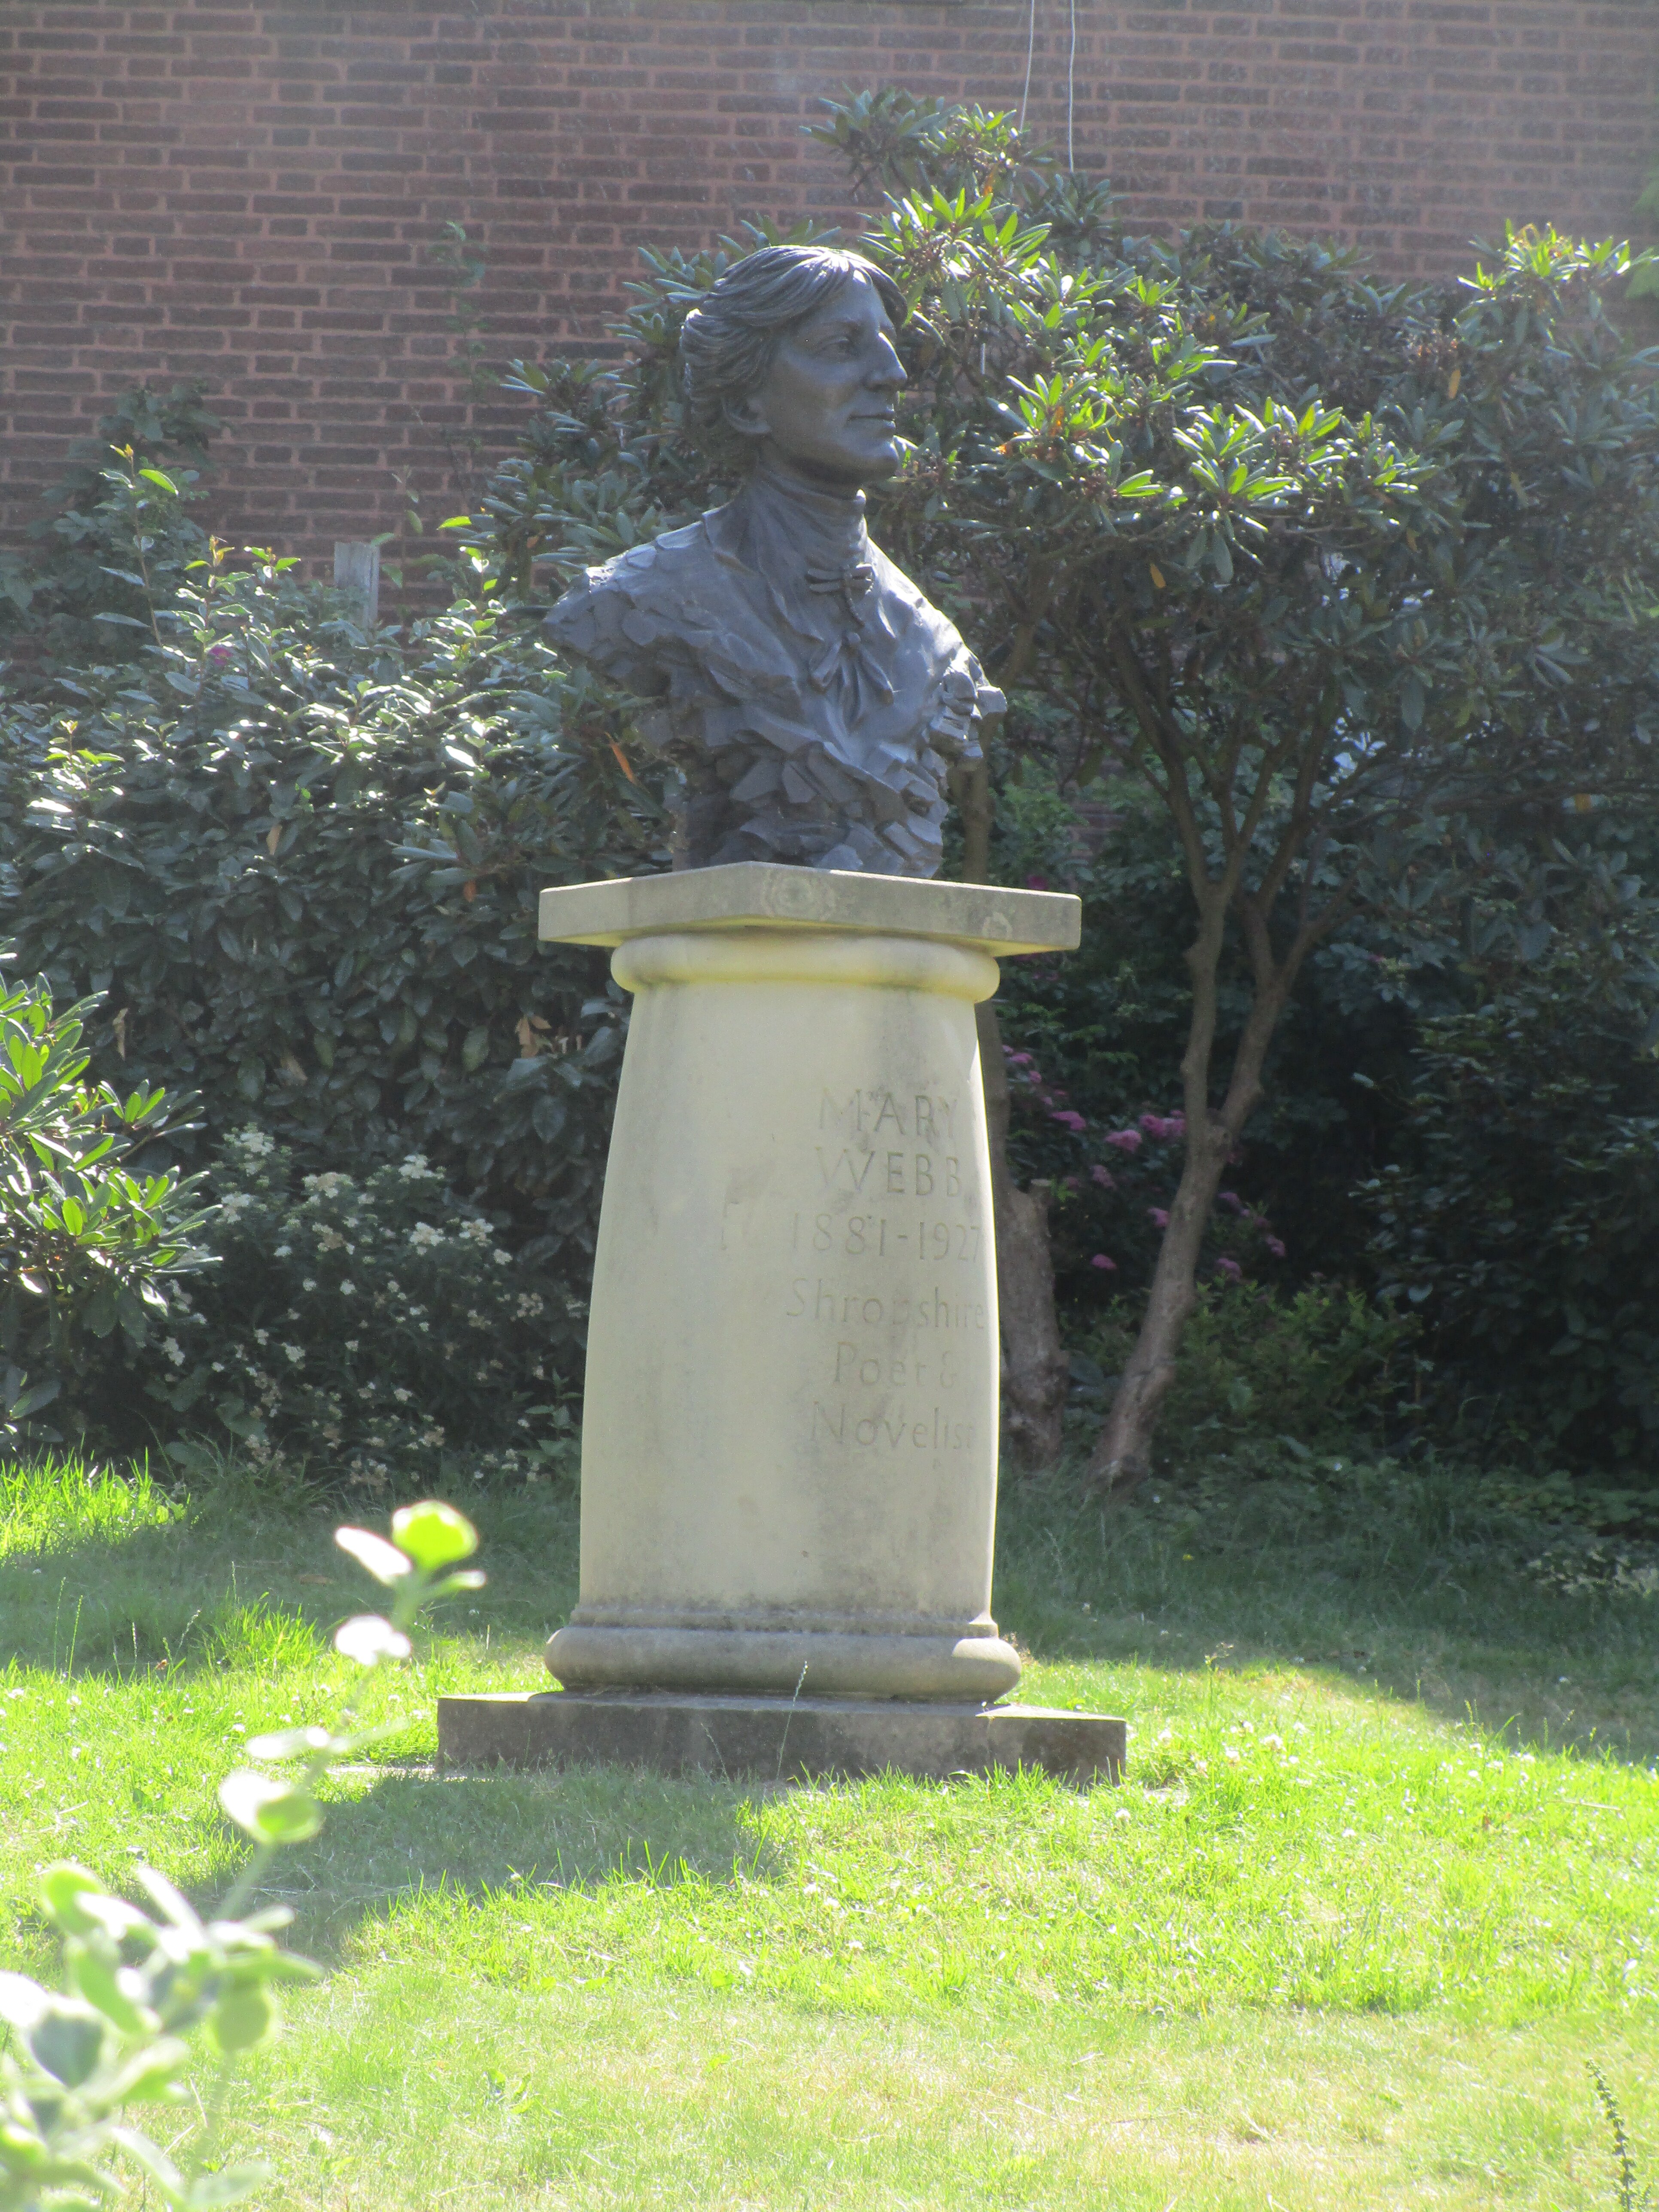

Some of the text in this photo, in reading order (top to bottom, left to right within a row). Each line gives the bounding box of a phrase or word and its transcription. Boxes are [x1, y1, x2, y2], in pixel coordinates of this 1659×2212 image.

[819, 1088, 958, 1138] MARY
[815, 1146, 962, 1197] WEBB
[792, 1212, 980, 1261] 1881-1927
[786, 1277, 985, 1333] Shropshire
[833, 1340, 927, 1387] Poet
[810, 1401, 975, 1450] Novelist
